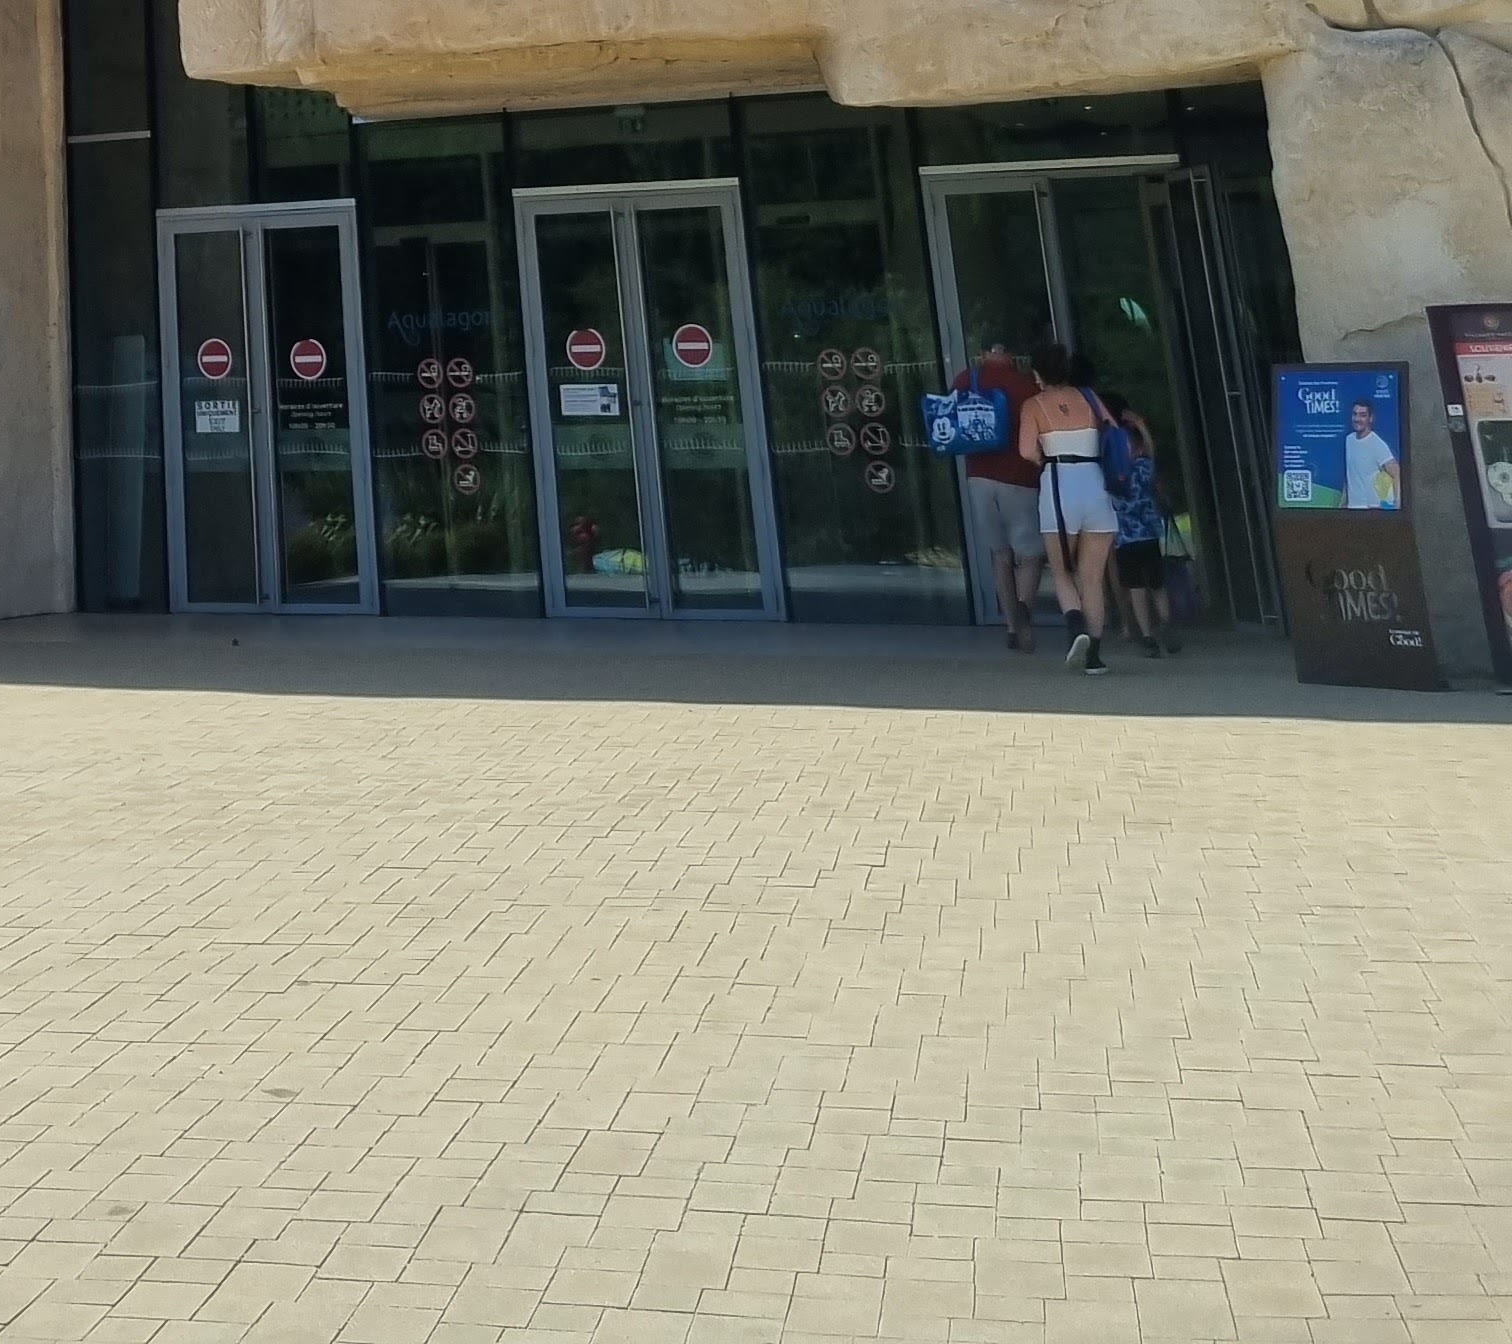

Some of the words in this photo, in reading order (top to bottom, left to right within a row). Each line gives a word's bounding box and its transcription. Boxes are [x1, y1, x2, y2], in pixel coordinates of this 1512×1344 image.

[1298, 388, 1336, 401] Good
[197, 401, 237, 410] SORTIE
[1305, 400, 1340, 414] TIMES!
